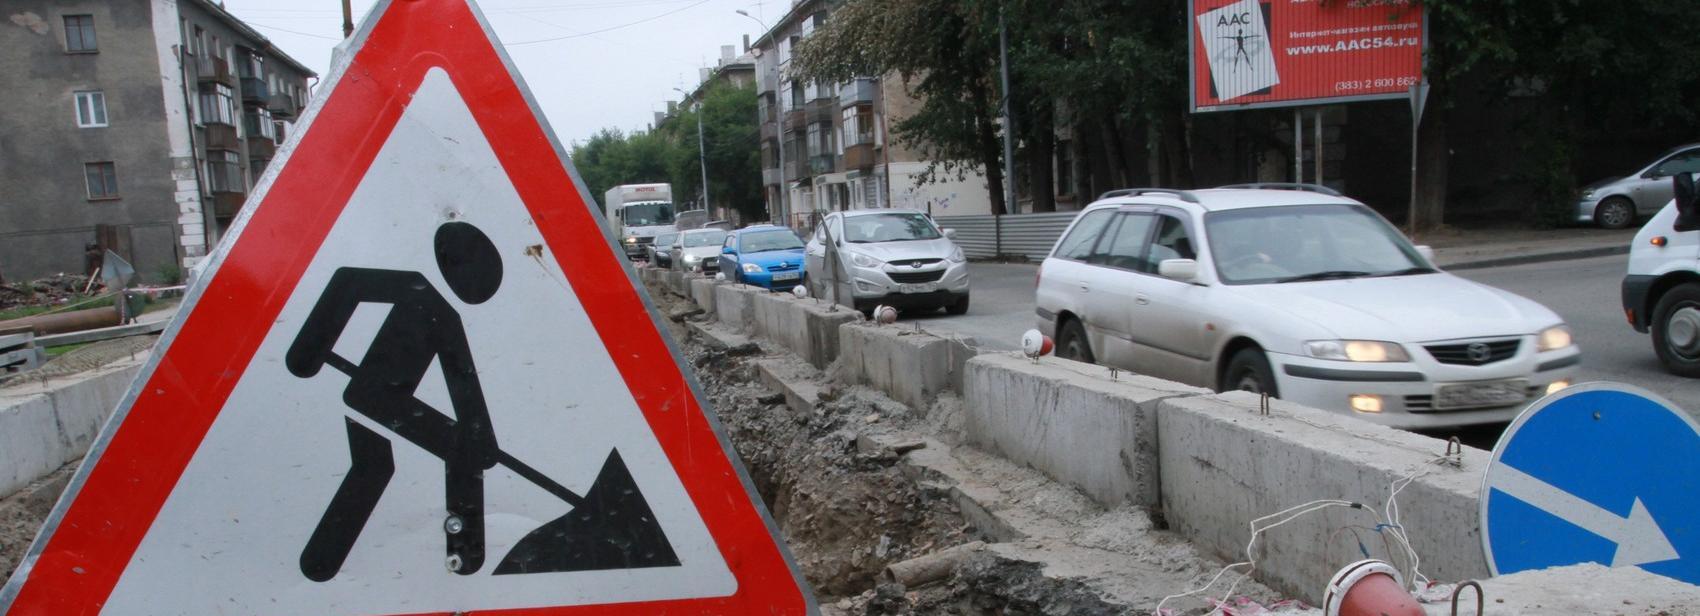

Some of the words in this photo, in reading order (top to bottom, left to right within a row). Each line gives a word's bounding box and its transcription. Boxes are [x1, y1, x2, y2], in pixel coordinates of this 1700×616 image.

[1217, 12, 1250, 27] AAC
[1286, 37, 1418, 56] www.AAC54.ru
[1335, 80, 1362, 92] (383)
[1365, 79, 1372, 89] 2
[1374, 78, 1394, 88] 600
